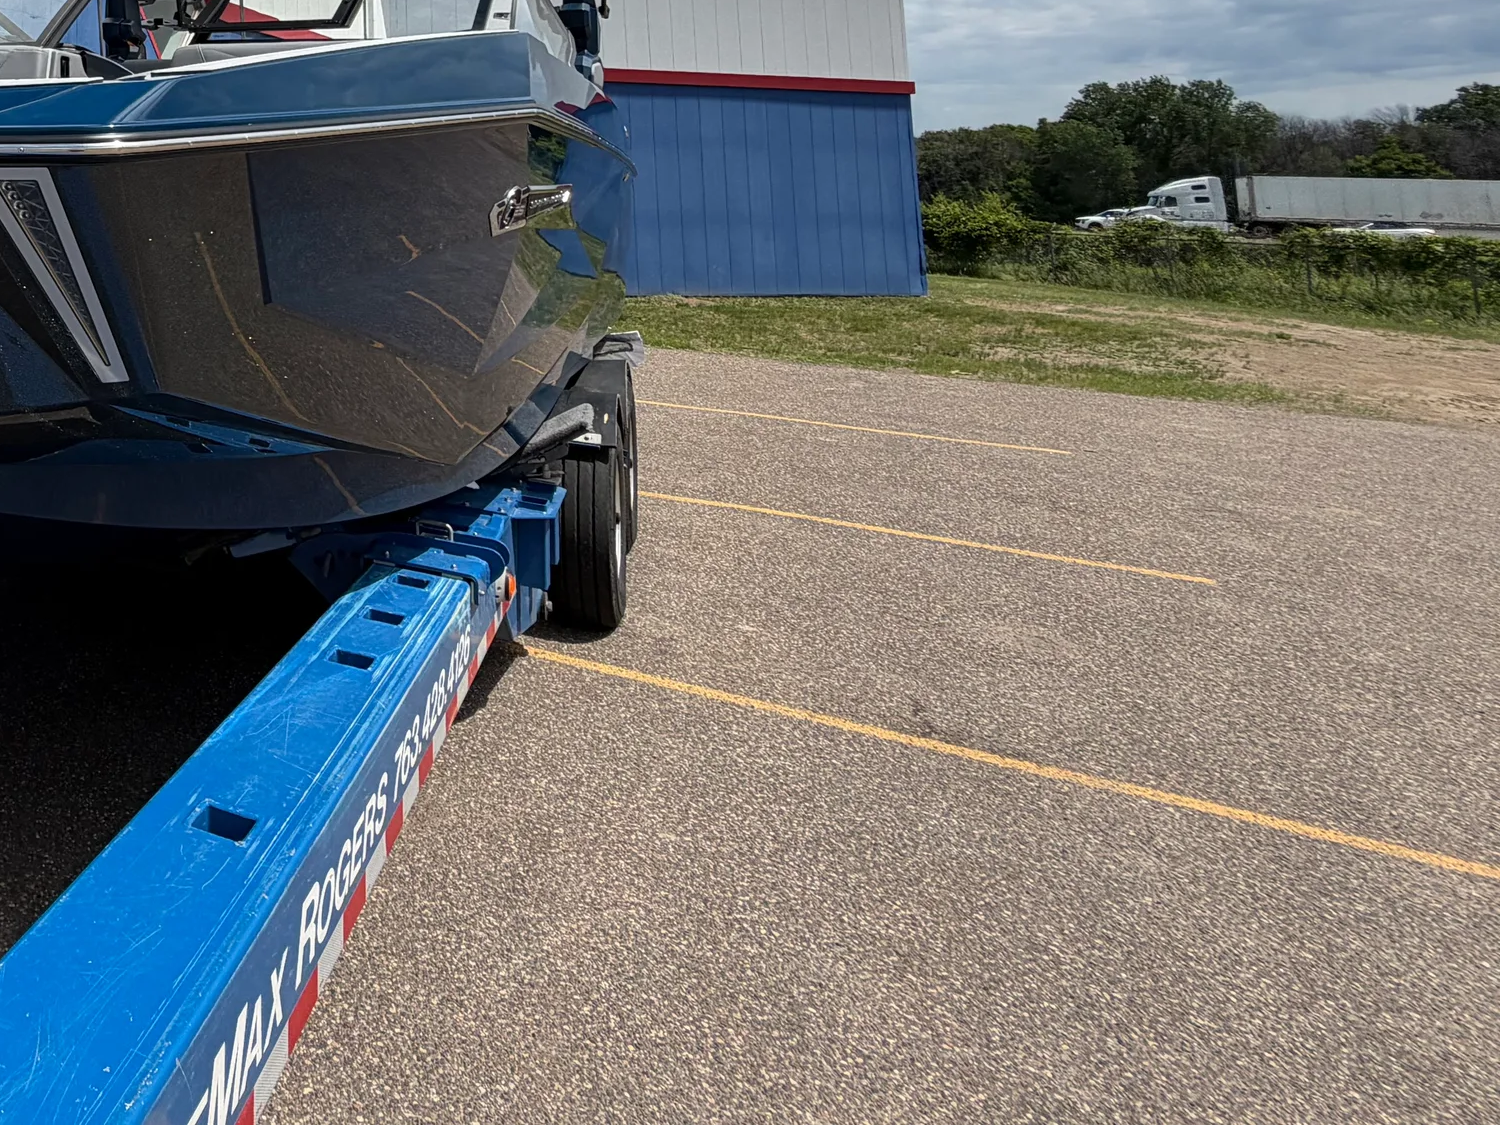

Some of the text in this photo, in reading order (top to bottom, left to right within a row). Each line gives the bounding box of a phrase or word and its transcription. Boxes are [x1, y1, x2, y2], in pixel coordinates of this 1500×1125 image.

[187, 624, 471, 1125] MAX ROGERS 763.428.4126
